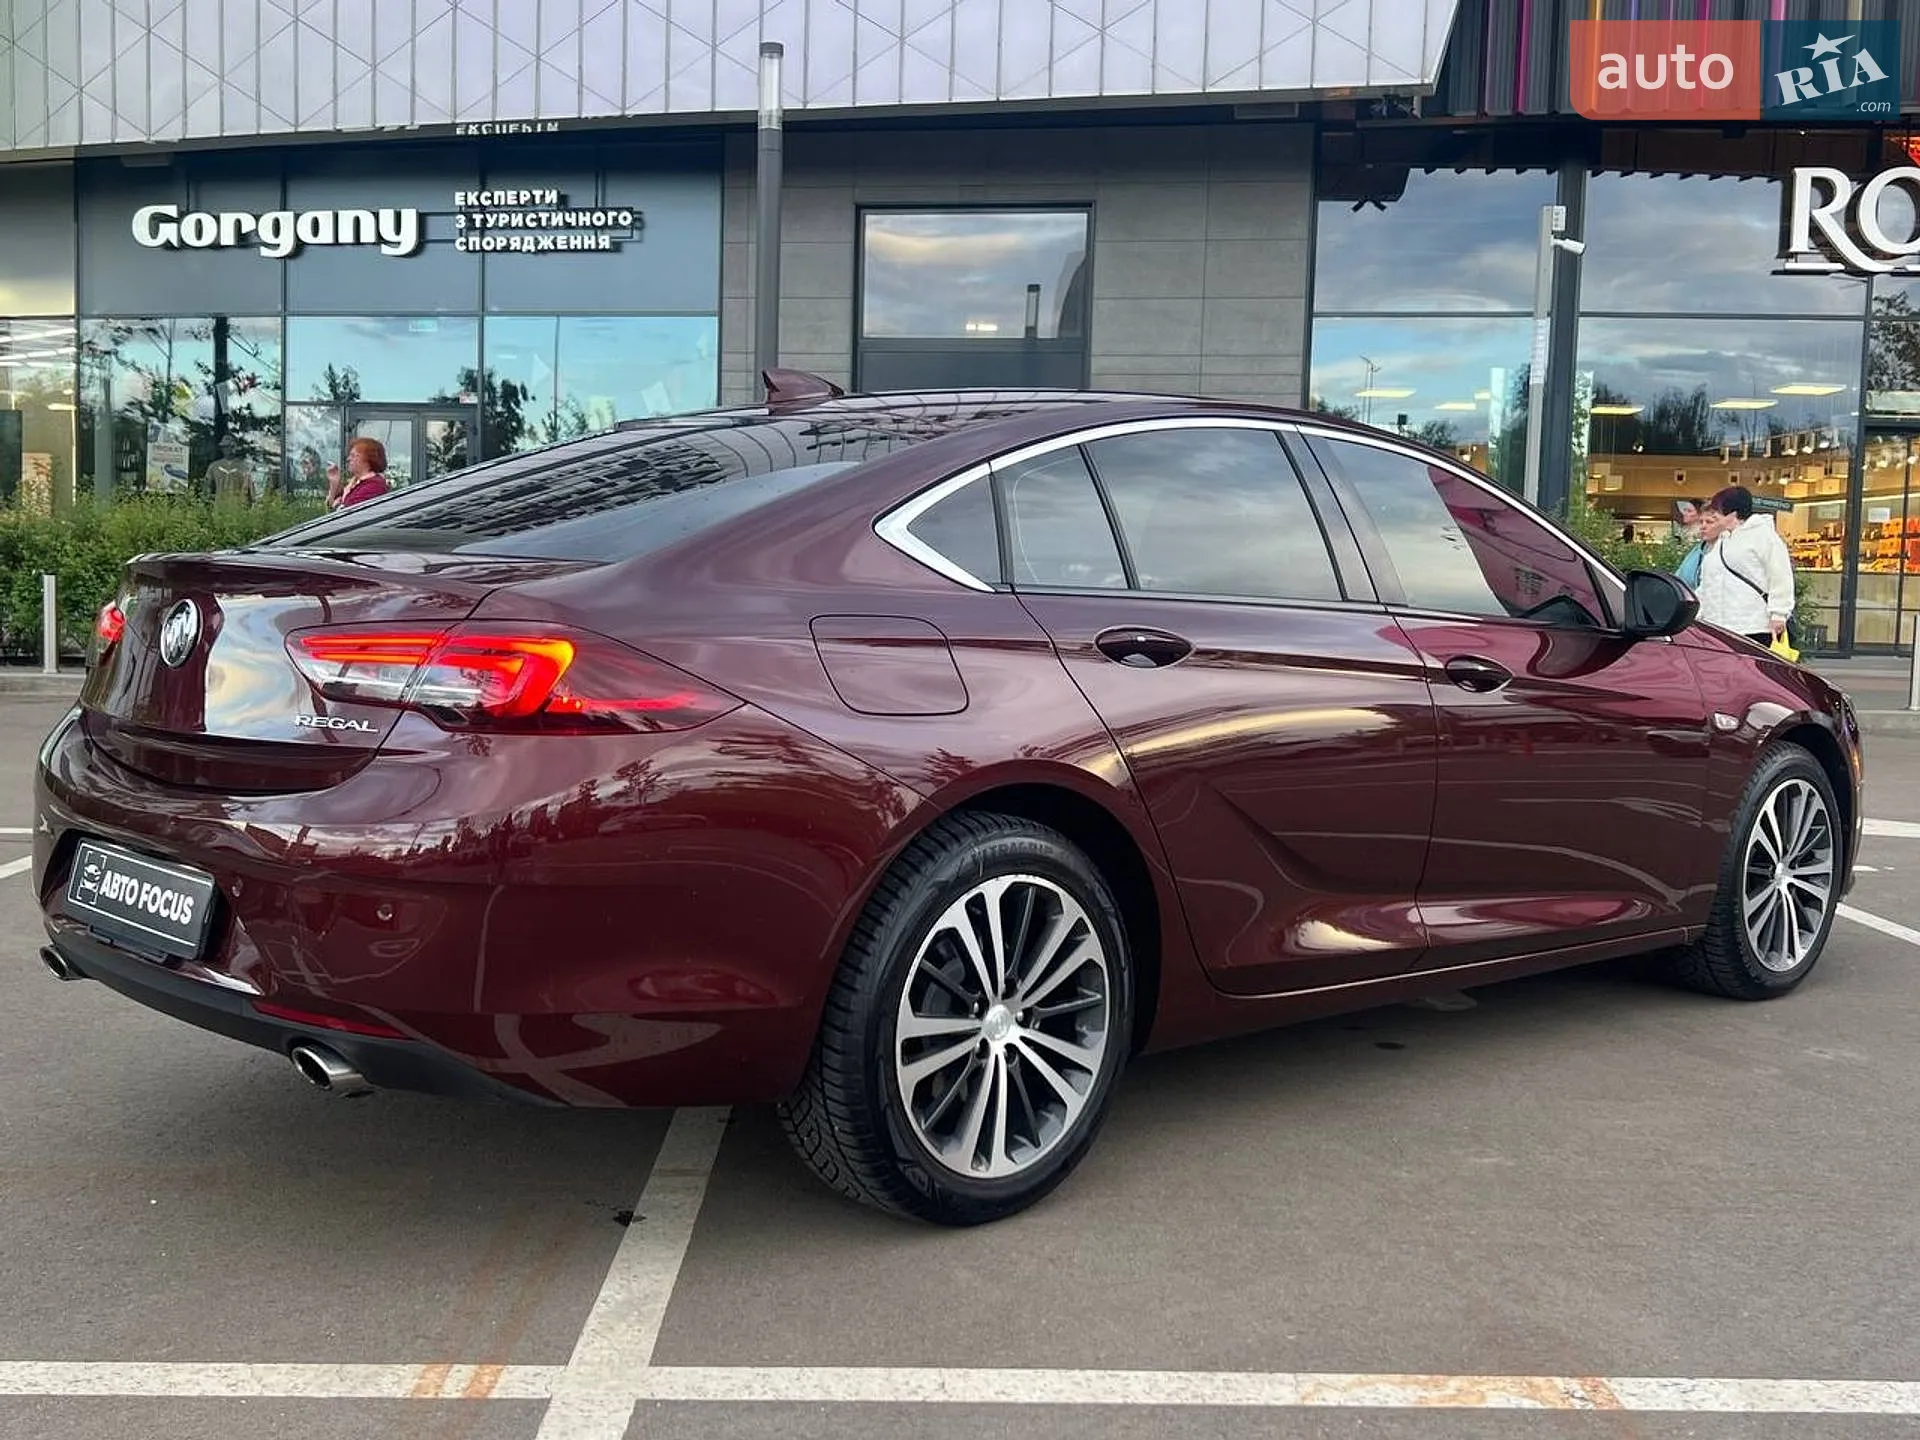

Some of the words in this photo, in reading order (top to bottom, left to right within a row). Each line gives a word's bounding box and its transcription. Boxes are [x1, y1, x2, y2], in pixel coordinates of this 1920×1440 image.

[454, 189, 558, 206] ЕКСПЕРТИ
[472, 211, 633, 228] ТУРИСТИЧНОГО
[132, 204, 417, 258] Gorgany
[454, 235, 611, 251] СПОРЯДЖЕННЯ
[294, 715, 379, 732] REGAL
[137, 882, 195, 926] FOCUS
